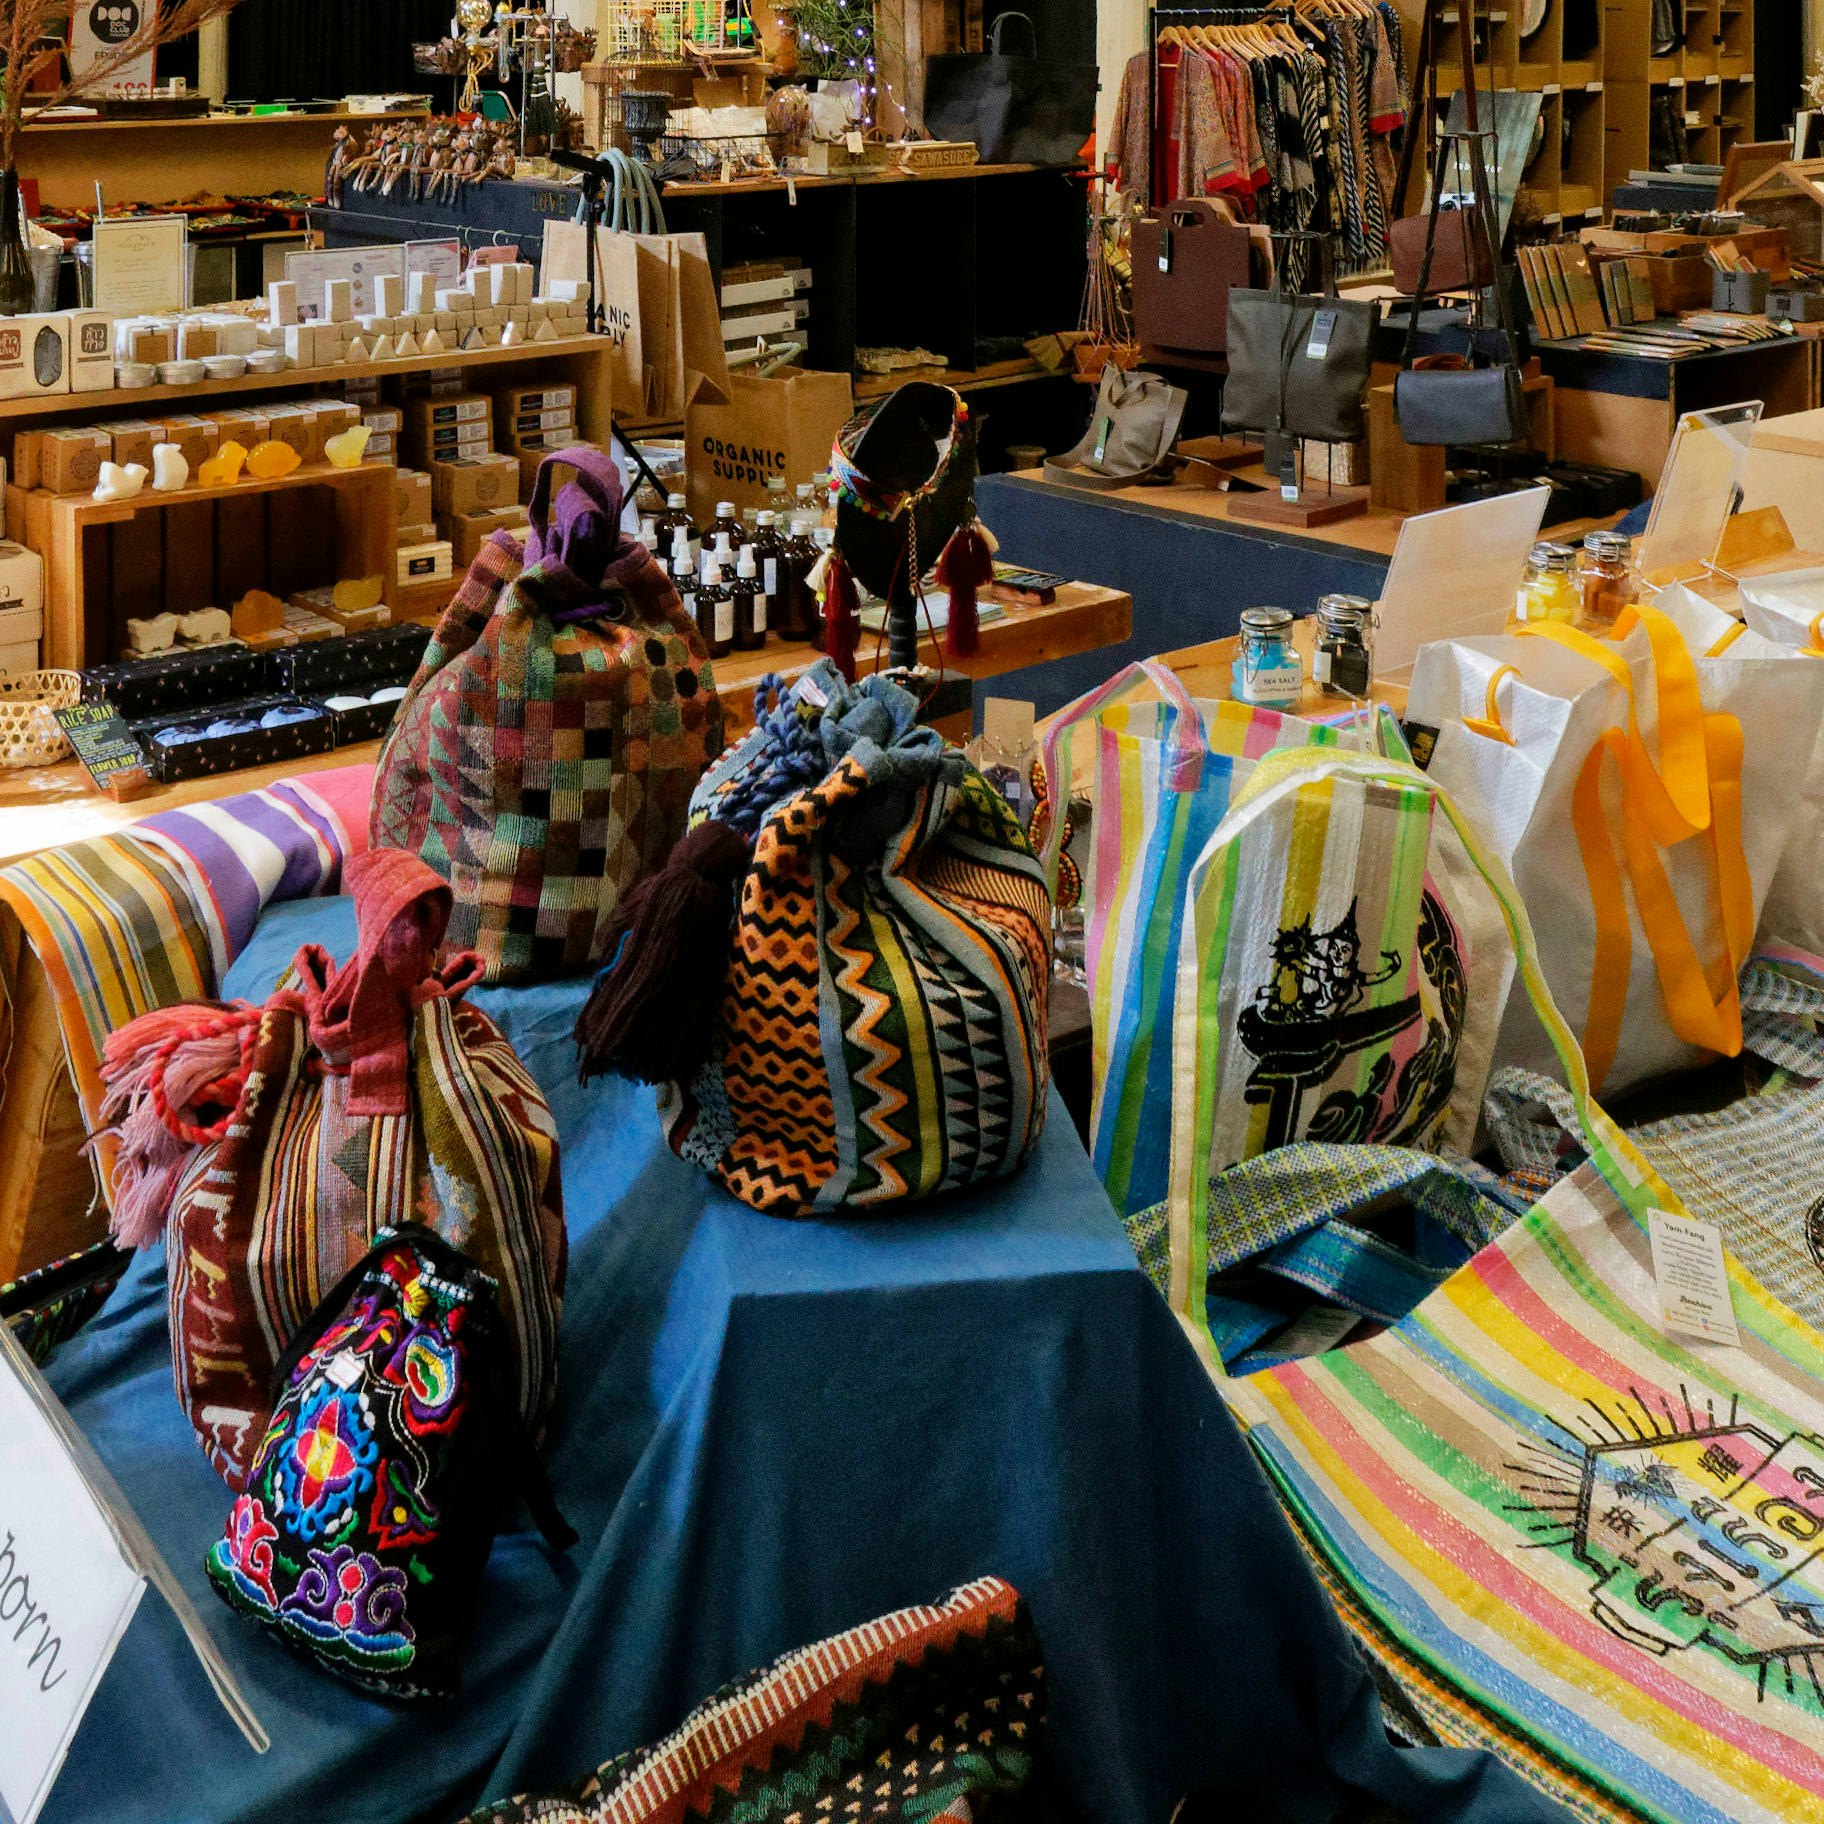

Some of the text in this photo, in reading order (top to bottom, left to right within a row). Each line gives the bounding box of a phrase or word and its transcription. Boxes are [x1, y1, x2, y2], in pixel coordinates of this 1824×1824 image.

[531, 190, 567, 216] LOVE
[703, 437, 786, 470] ORGANIC
[58, 704, 114, 729] RICE SOAP
